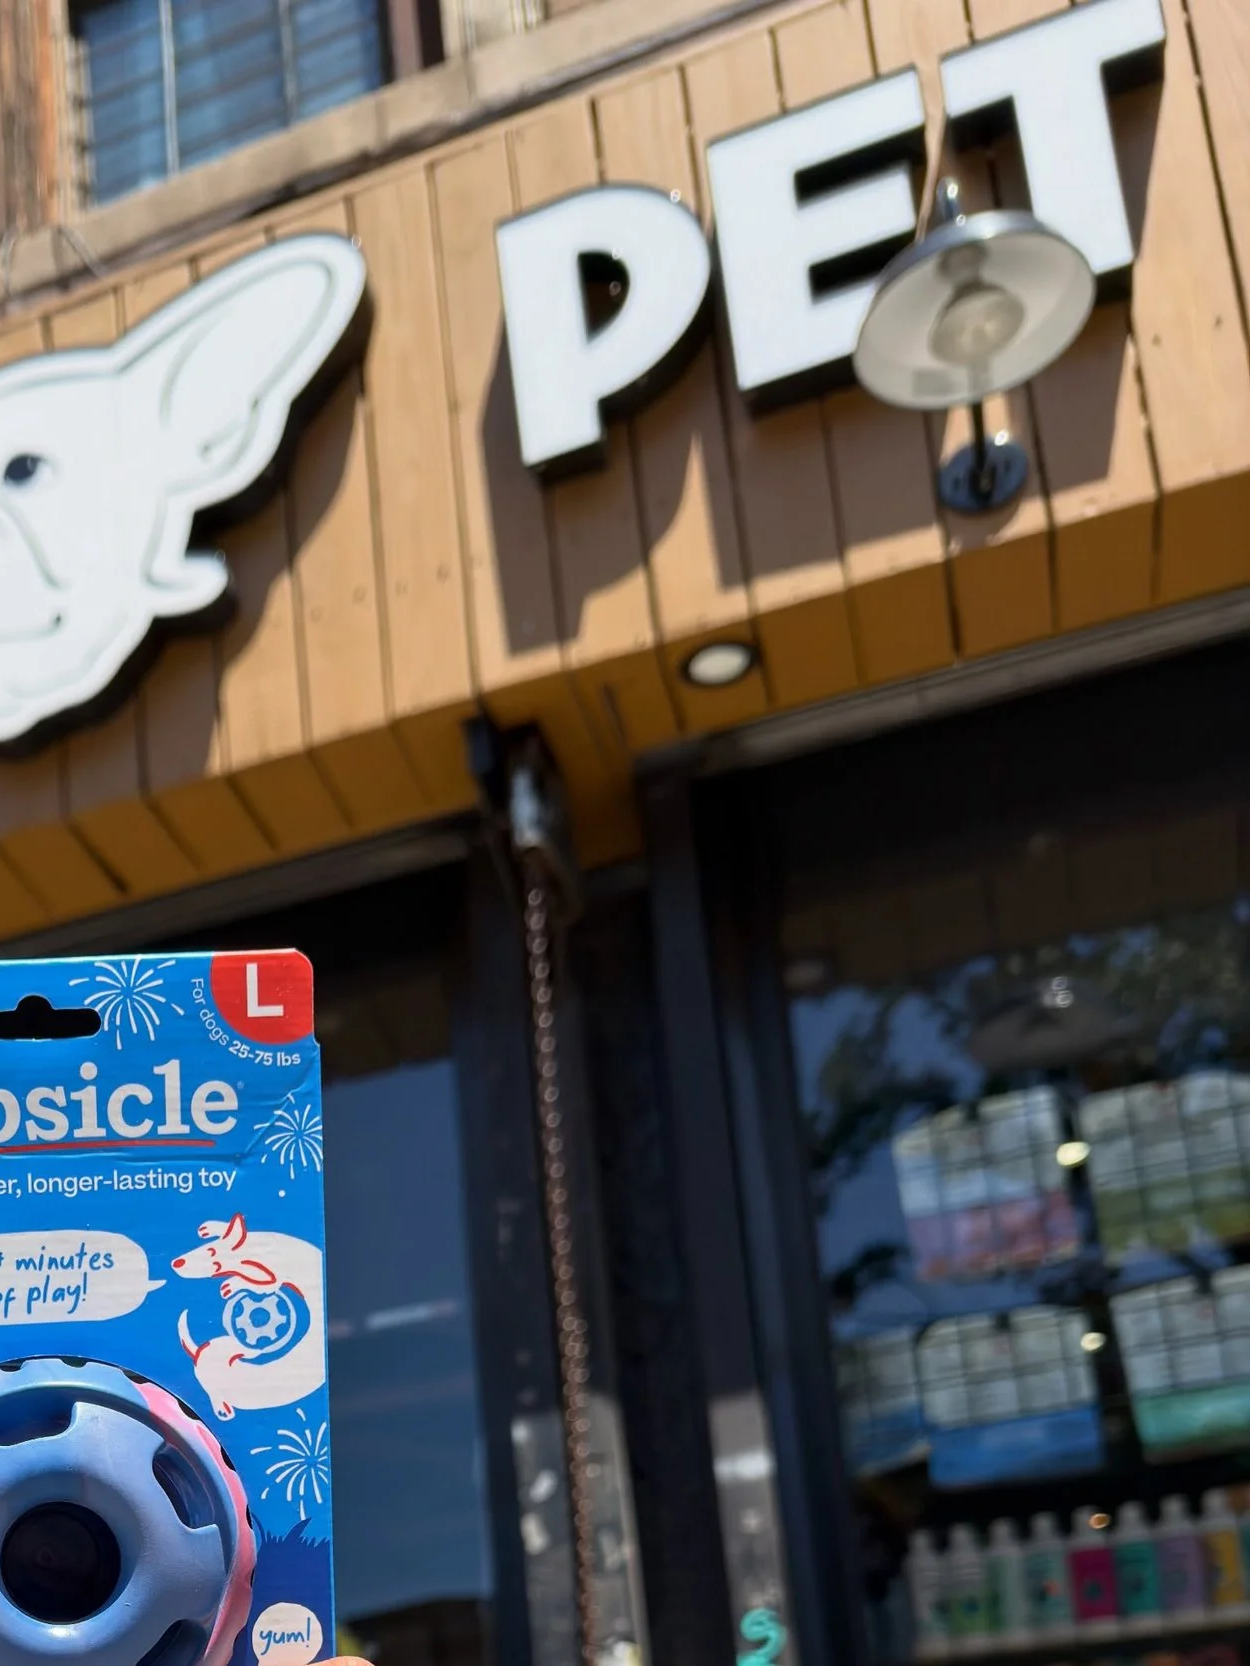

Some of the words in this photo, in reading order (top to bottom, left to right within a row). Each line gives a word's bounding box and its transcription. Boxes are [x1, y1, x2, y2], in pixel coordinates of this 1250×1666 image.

[495, 0, 1166, 467] PET
[246, 962, 284, 1017] L
[190, 978, 206, 1006] For
[199, 1008, 230, 1046] dogs
[228, 1040, 273, 1066] 25-75
[277, 1051, 301, 1067] lbs
[27, 1168, 194, 1198] longer-lasting
[198, 1167, 237, 1192] toy
[15, 1242, 115, 1272] minutes
[26, 1272, 88, 1315] play!
[259, 1616, 311, 1656] yum!
